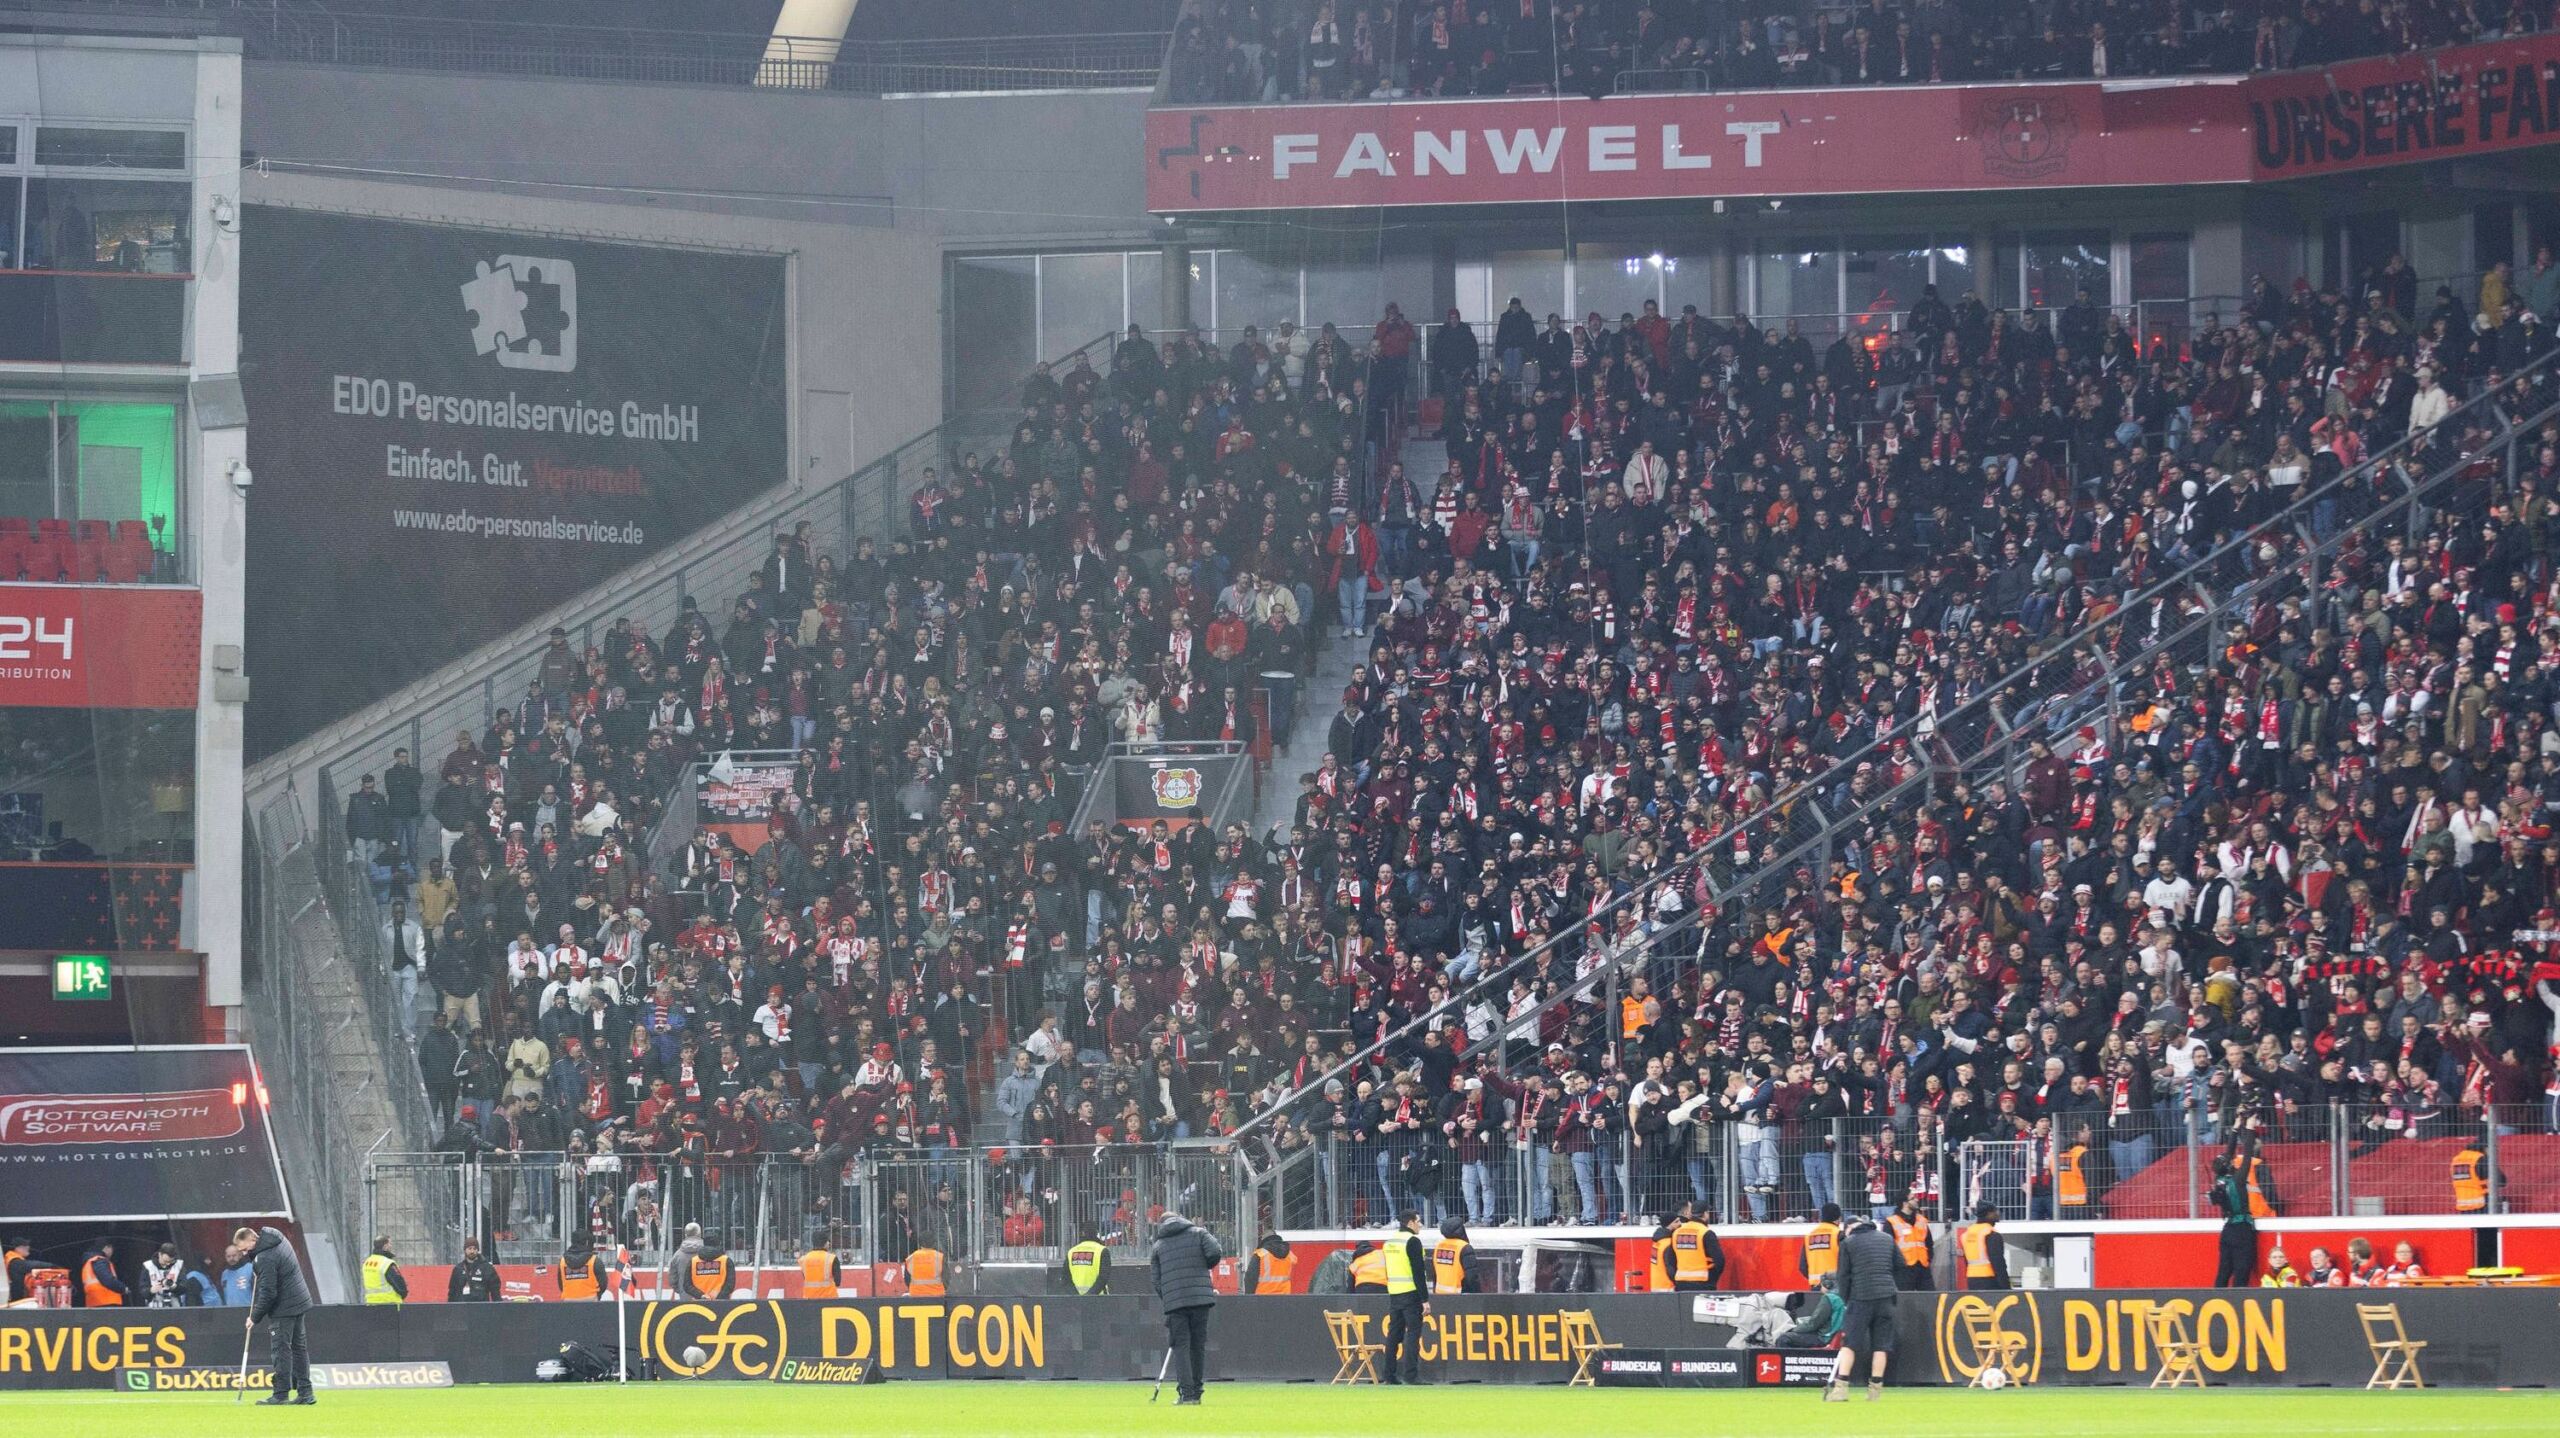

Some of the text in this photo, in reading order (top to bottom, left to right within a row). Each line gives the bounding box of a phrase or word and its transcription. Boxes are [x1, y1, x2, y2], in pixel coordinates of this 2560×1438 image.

[2251, 73, 2466, 170] UNSERE
[1272, 120, 1781, 181] FANWELT
[334, 374, 699, 442] EDO Personalservice GmbH
[386, 443, 477, 484] Einfach.
[483, 452, 529, 488] Gut.
[393, 507, 644, 545] www.edo-personalservice.de
[22, 1106, 209, 1122] HOTTGENROTH
[24, 1121, 163, 1135] SOFTWARE
[821, 1303, 1045, 1369] DITCON
[2063, 1298, 2287, 1373] DITCON
[0, 1327, 187, 1373] RVICES
[1798, 1356, 1835, 1366] OFFIZIELL
[156, 1368, 275, 1390] buXtrade
[331, 1362, 443, 1386] buXtrade
[796, 1361, 863, 1383] buXtrade
[1611, 1360, 1662, 1374] BUNDESLIGA
[1681, 1360, 1737, 1374] BUNDESLIGA
[1785, 1373, 1802, 1382] APP
